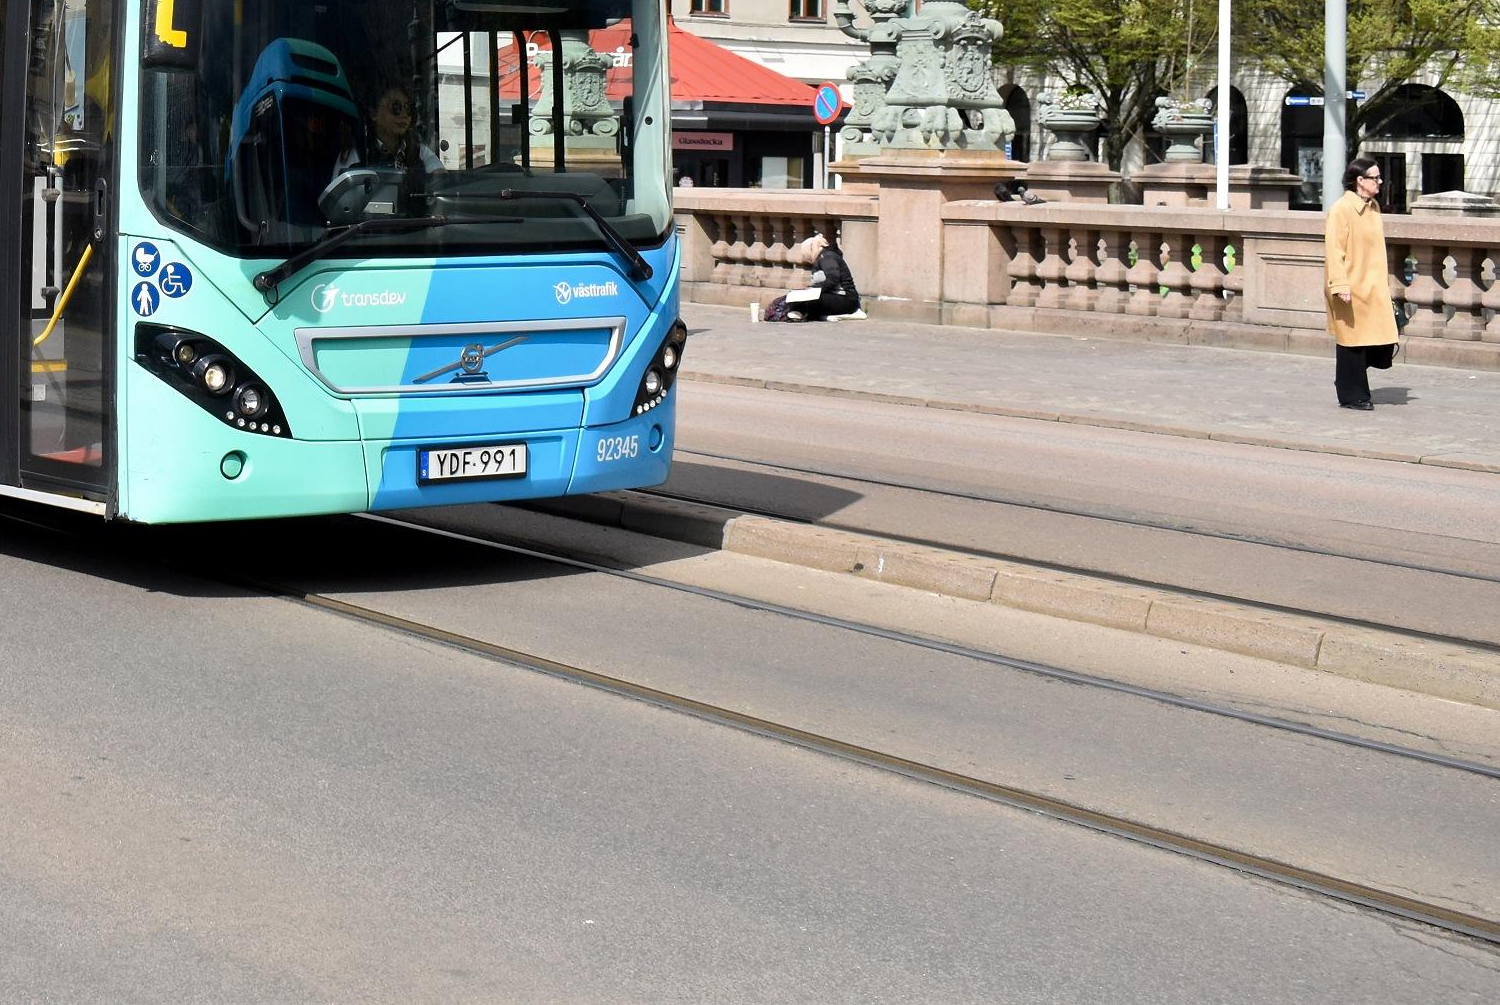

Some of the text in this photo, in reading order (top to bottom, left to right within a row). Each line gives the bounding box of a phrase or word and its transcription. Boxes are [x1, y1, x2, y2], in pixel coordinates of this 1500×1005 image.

[341, 290, 406, 307] transdev
[573, 281, 618, 298] västtrafik
[597, 435, 639, 462] 92345
[437, 449, 516, 476] YDF 991
